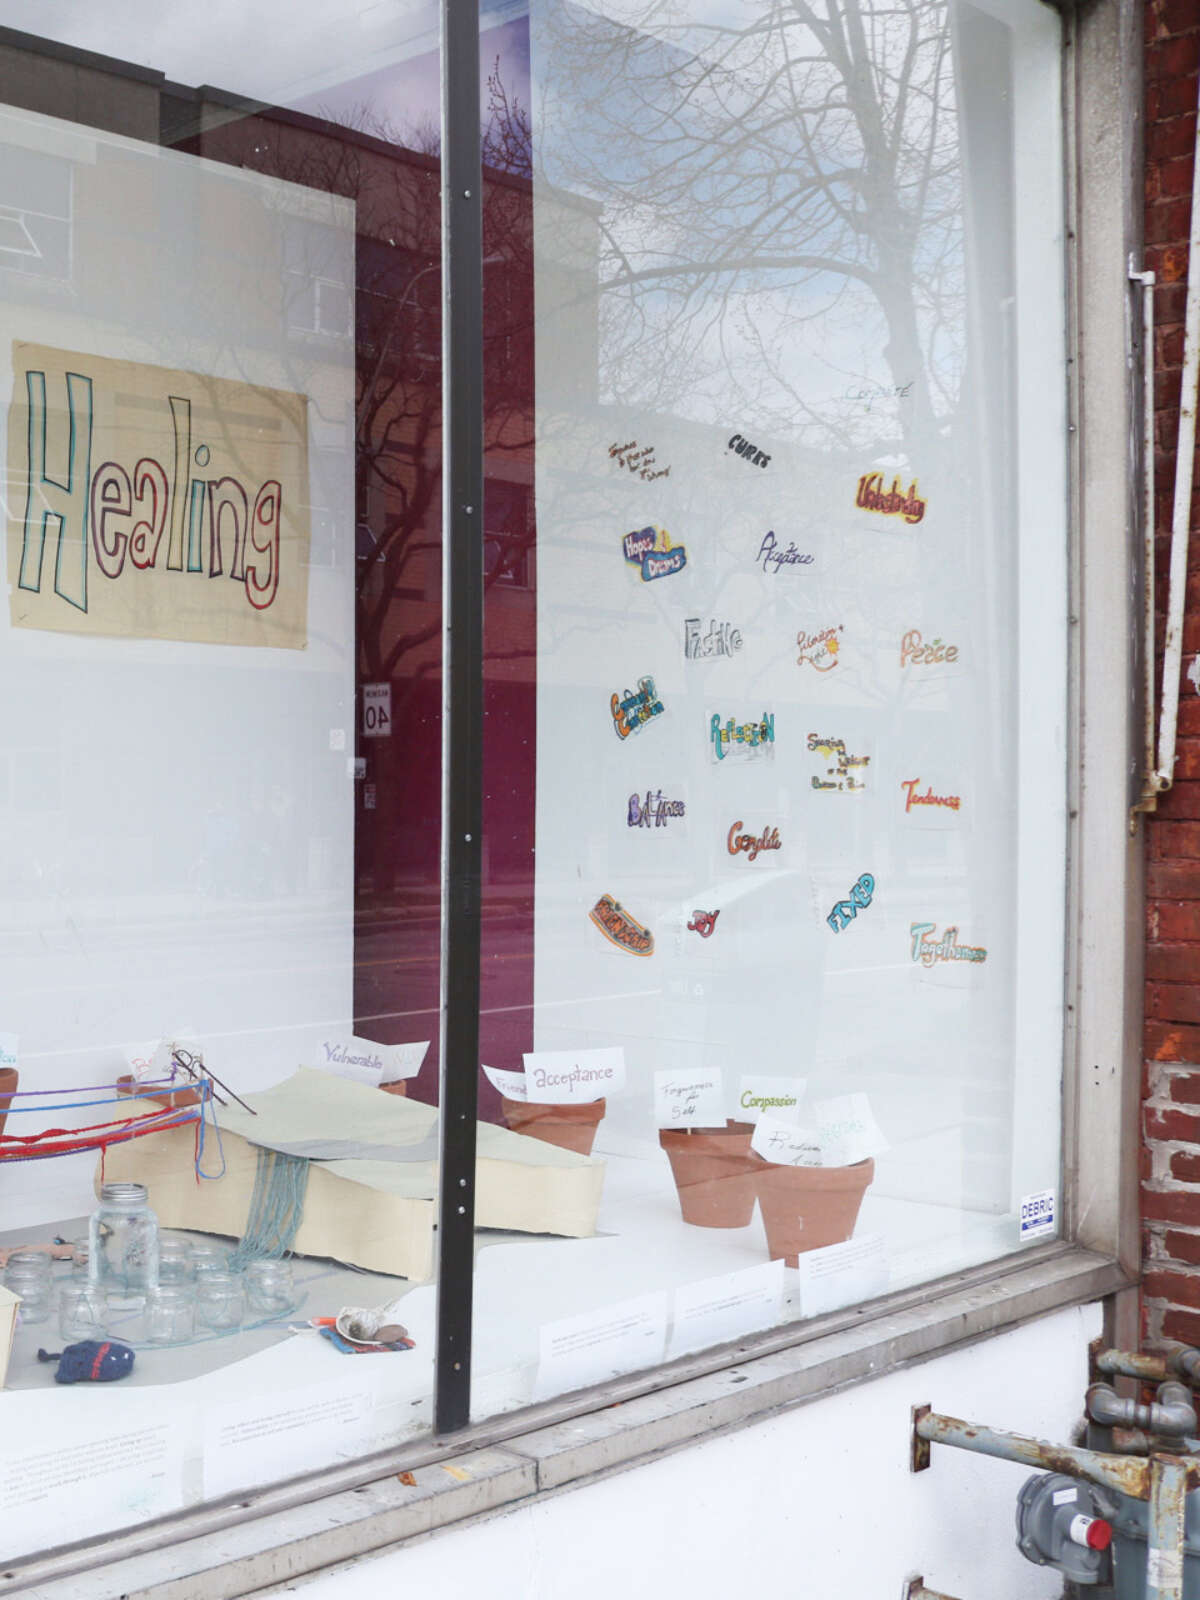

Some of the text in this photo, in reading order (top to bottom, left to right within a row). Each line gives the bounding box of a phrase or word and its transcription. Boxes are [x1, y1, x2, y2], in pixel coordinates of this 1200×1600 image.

[19, 370, 282, 612] Healing
[901, 629, 960, 668] Peace
[323, 1041, 384, 1070] Vulnerable
[532, 1063, 615, 1093] acceptance
